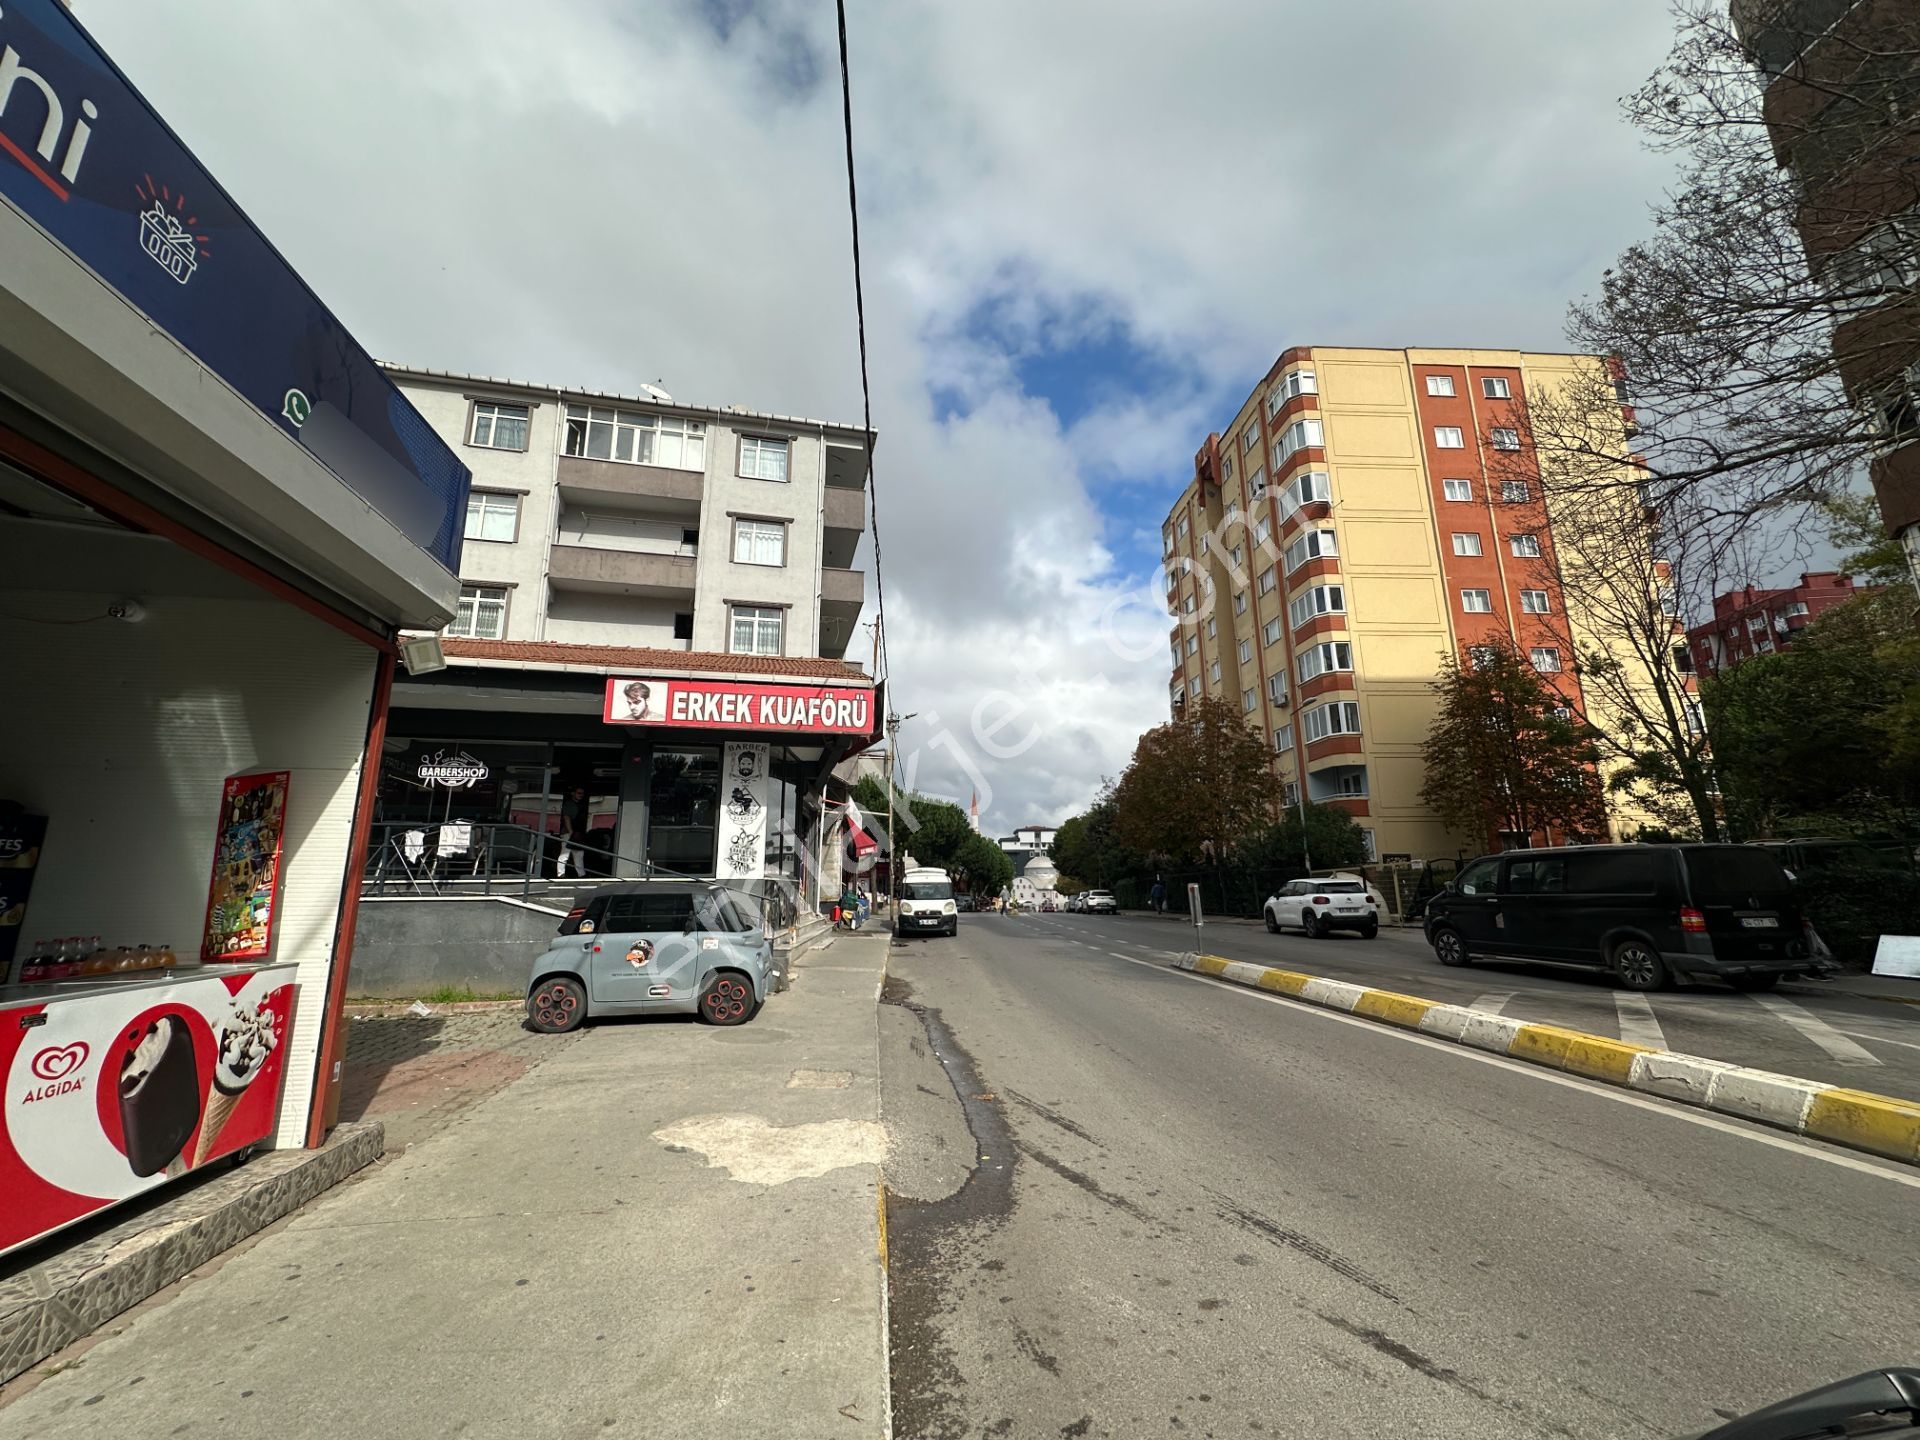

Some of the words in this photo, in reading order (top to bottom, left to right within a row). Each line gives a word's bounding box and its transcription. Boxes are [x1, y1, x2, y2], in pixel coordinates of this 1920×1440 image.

[0, 4, 98, 184] ni
[672, 691, 753, 723] ERKEK
[759, 692, 867, 728] KUAFÖRÜ
[728, 743, 767, 753] BARBER
[421, 767, 486, 778] BARBERSHOP
